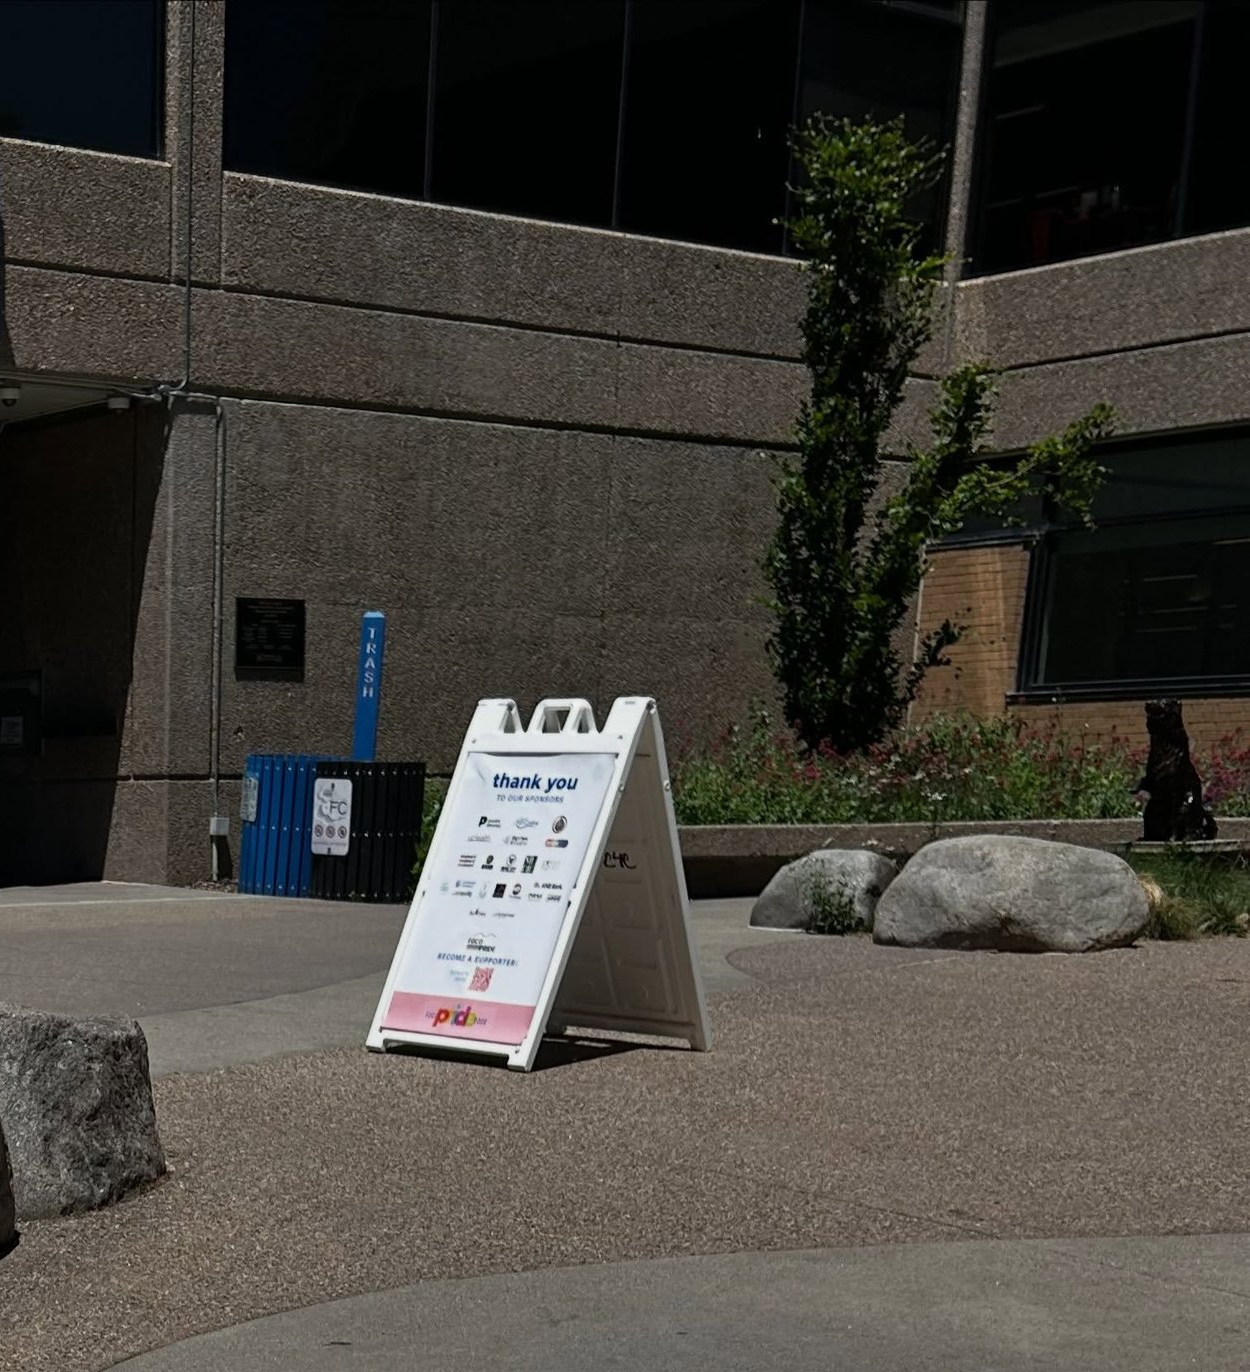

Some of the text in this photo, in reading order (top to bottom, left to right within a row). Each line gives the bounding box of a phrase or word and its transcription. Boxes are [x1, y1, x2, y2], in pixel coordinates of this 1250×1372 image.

[362, 627, 377, 698] TRASH
[493, 772, 579, 793] thank you
[496, 794, 507, 802] TO
[524, 795, 564, 804] SPONSORS
[329, 800, 348, 816] FC
[437, 952, 466, 961] BECOME
